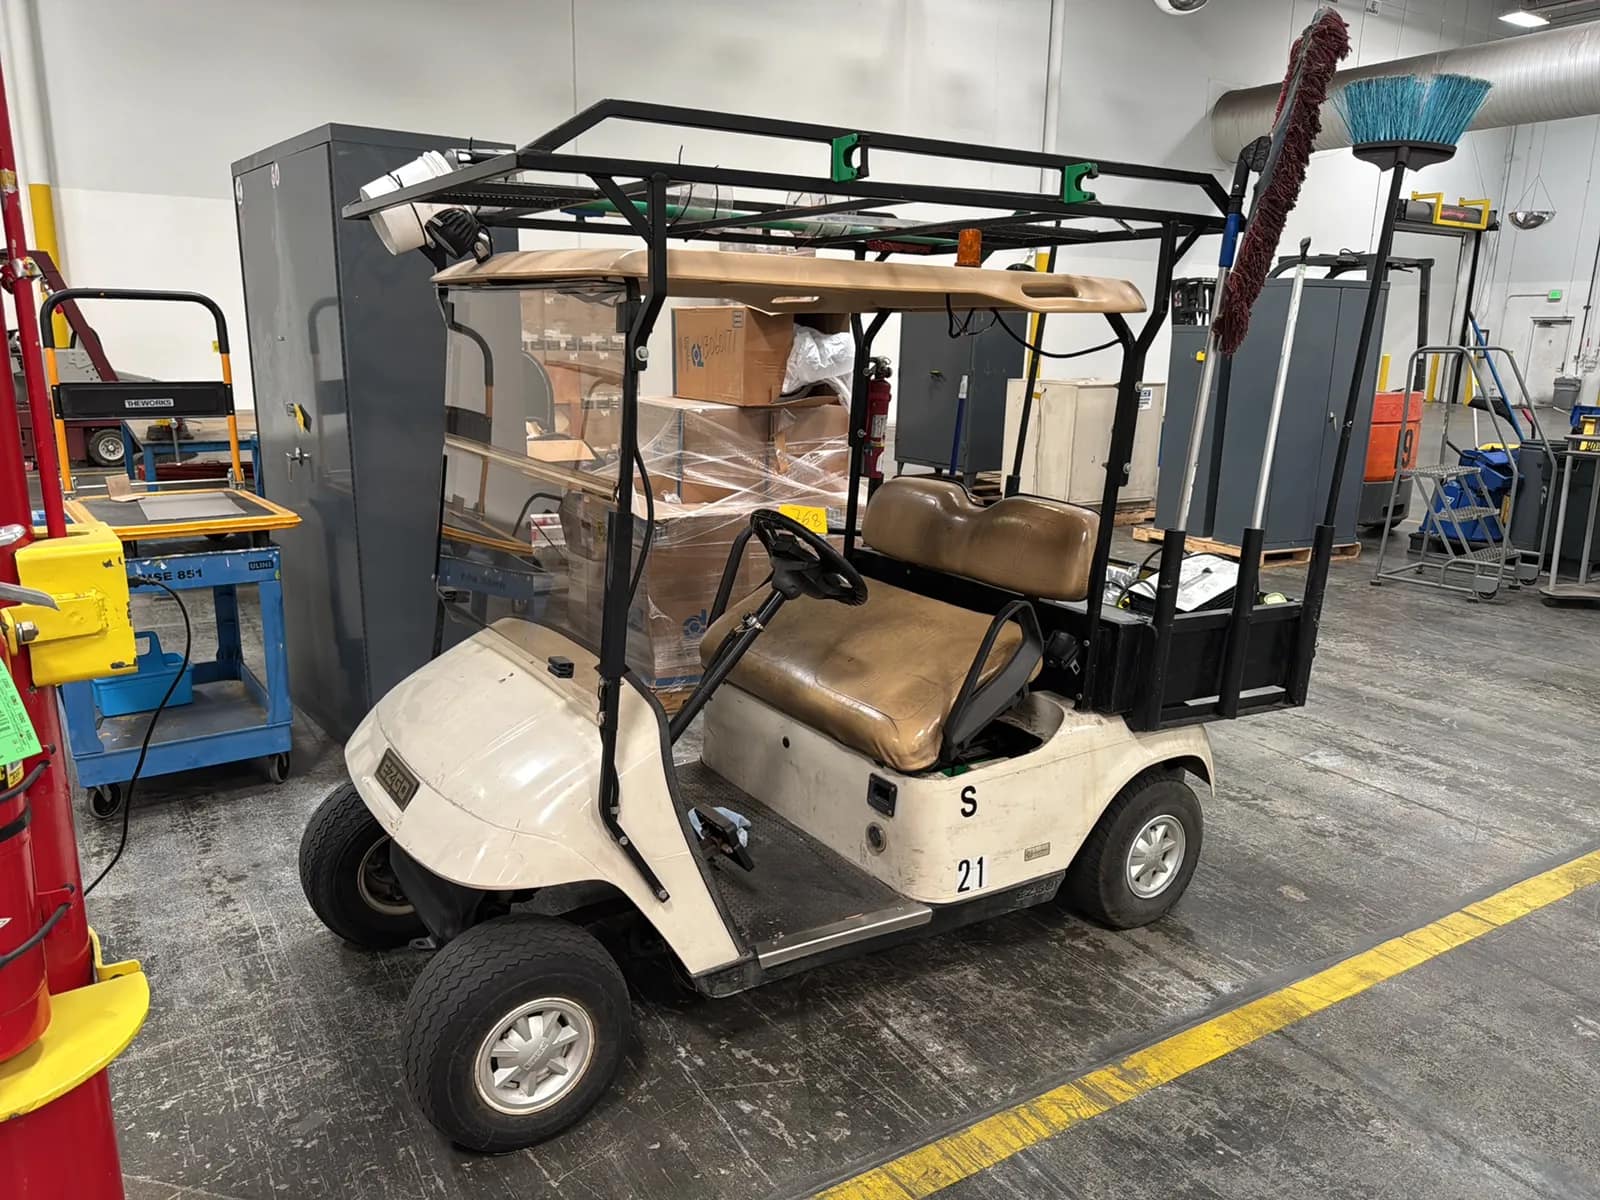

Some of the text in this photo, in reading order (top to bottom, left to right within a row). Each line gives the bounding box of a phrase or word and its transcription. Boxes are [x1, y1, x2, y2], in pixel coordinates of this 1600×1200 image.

[178, 569, 203, 581] 851
[960, 785, 977, 818] S
[957, 856, 983, 893] 21
